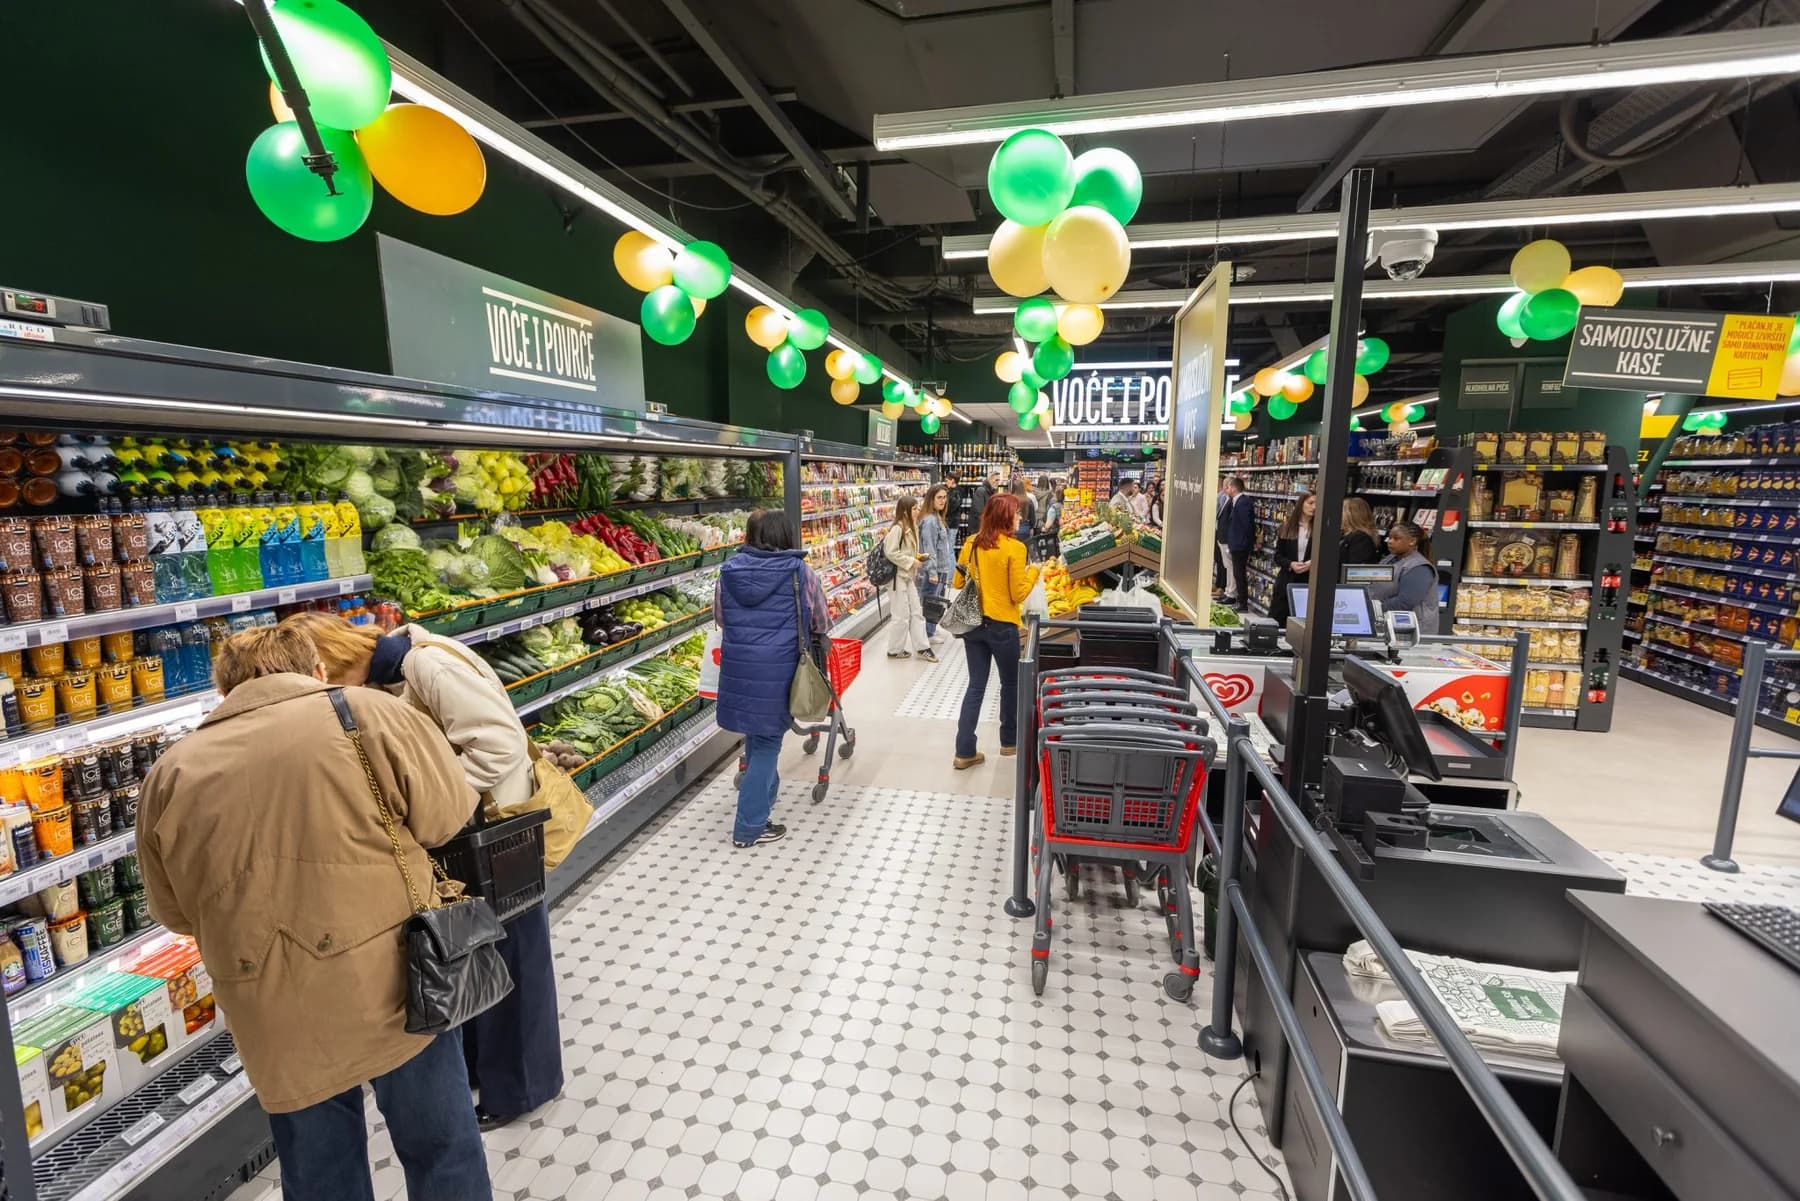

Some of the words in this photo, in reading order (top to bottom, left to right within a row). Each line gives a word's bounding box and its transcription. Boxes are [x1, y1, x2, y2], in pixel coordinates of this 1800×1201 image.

[486, 301, 533, 369] VOĆE
[532, 316, 543, 372] I
[543, 319, 597, 382] POVRĆE
[1580, 323, 1714, 353] SAMOUSLUŽNE
[1616, 351, 1664, 376] KASE
[1053, 370, 1114, 425] VOĆE
[1119, 376, 1133, 424] I
[1138, 374, 1240, 425] POE
[9, 541, 31, 552] ICE
[95, 583, 116, 595] ICE
[11, 593, 35, 606] ICE
[70, 693, 91, 704] ICE
[24, 702, 48, 714] ICE
[82, 768, 101, 781] ICE
[36, 928, 54, 977] EISKAFFEE
